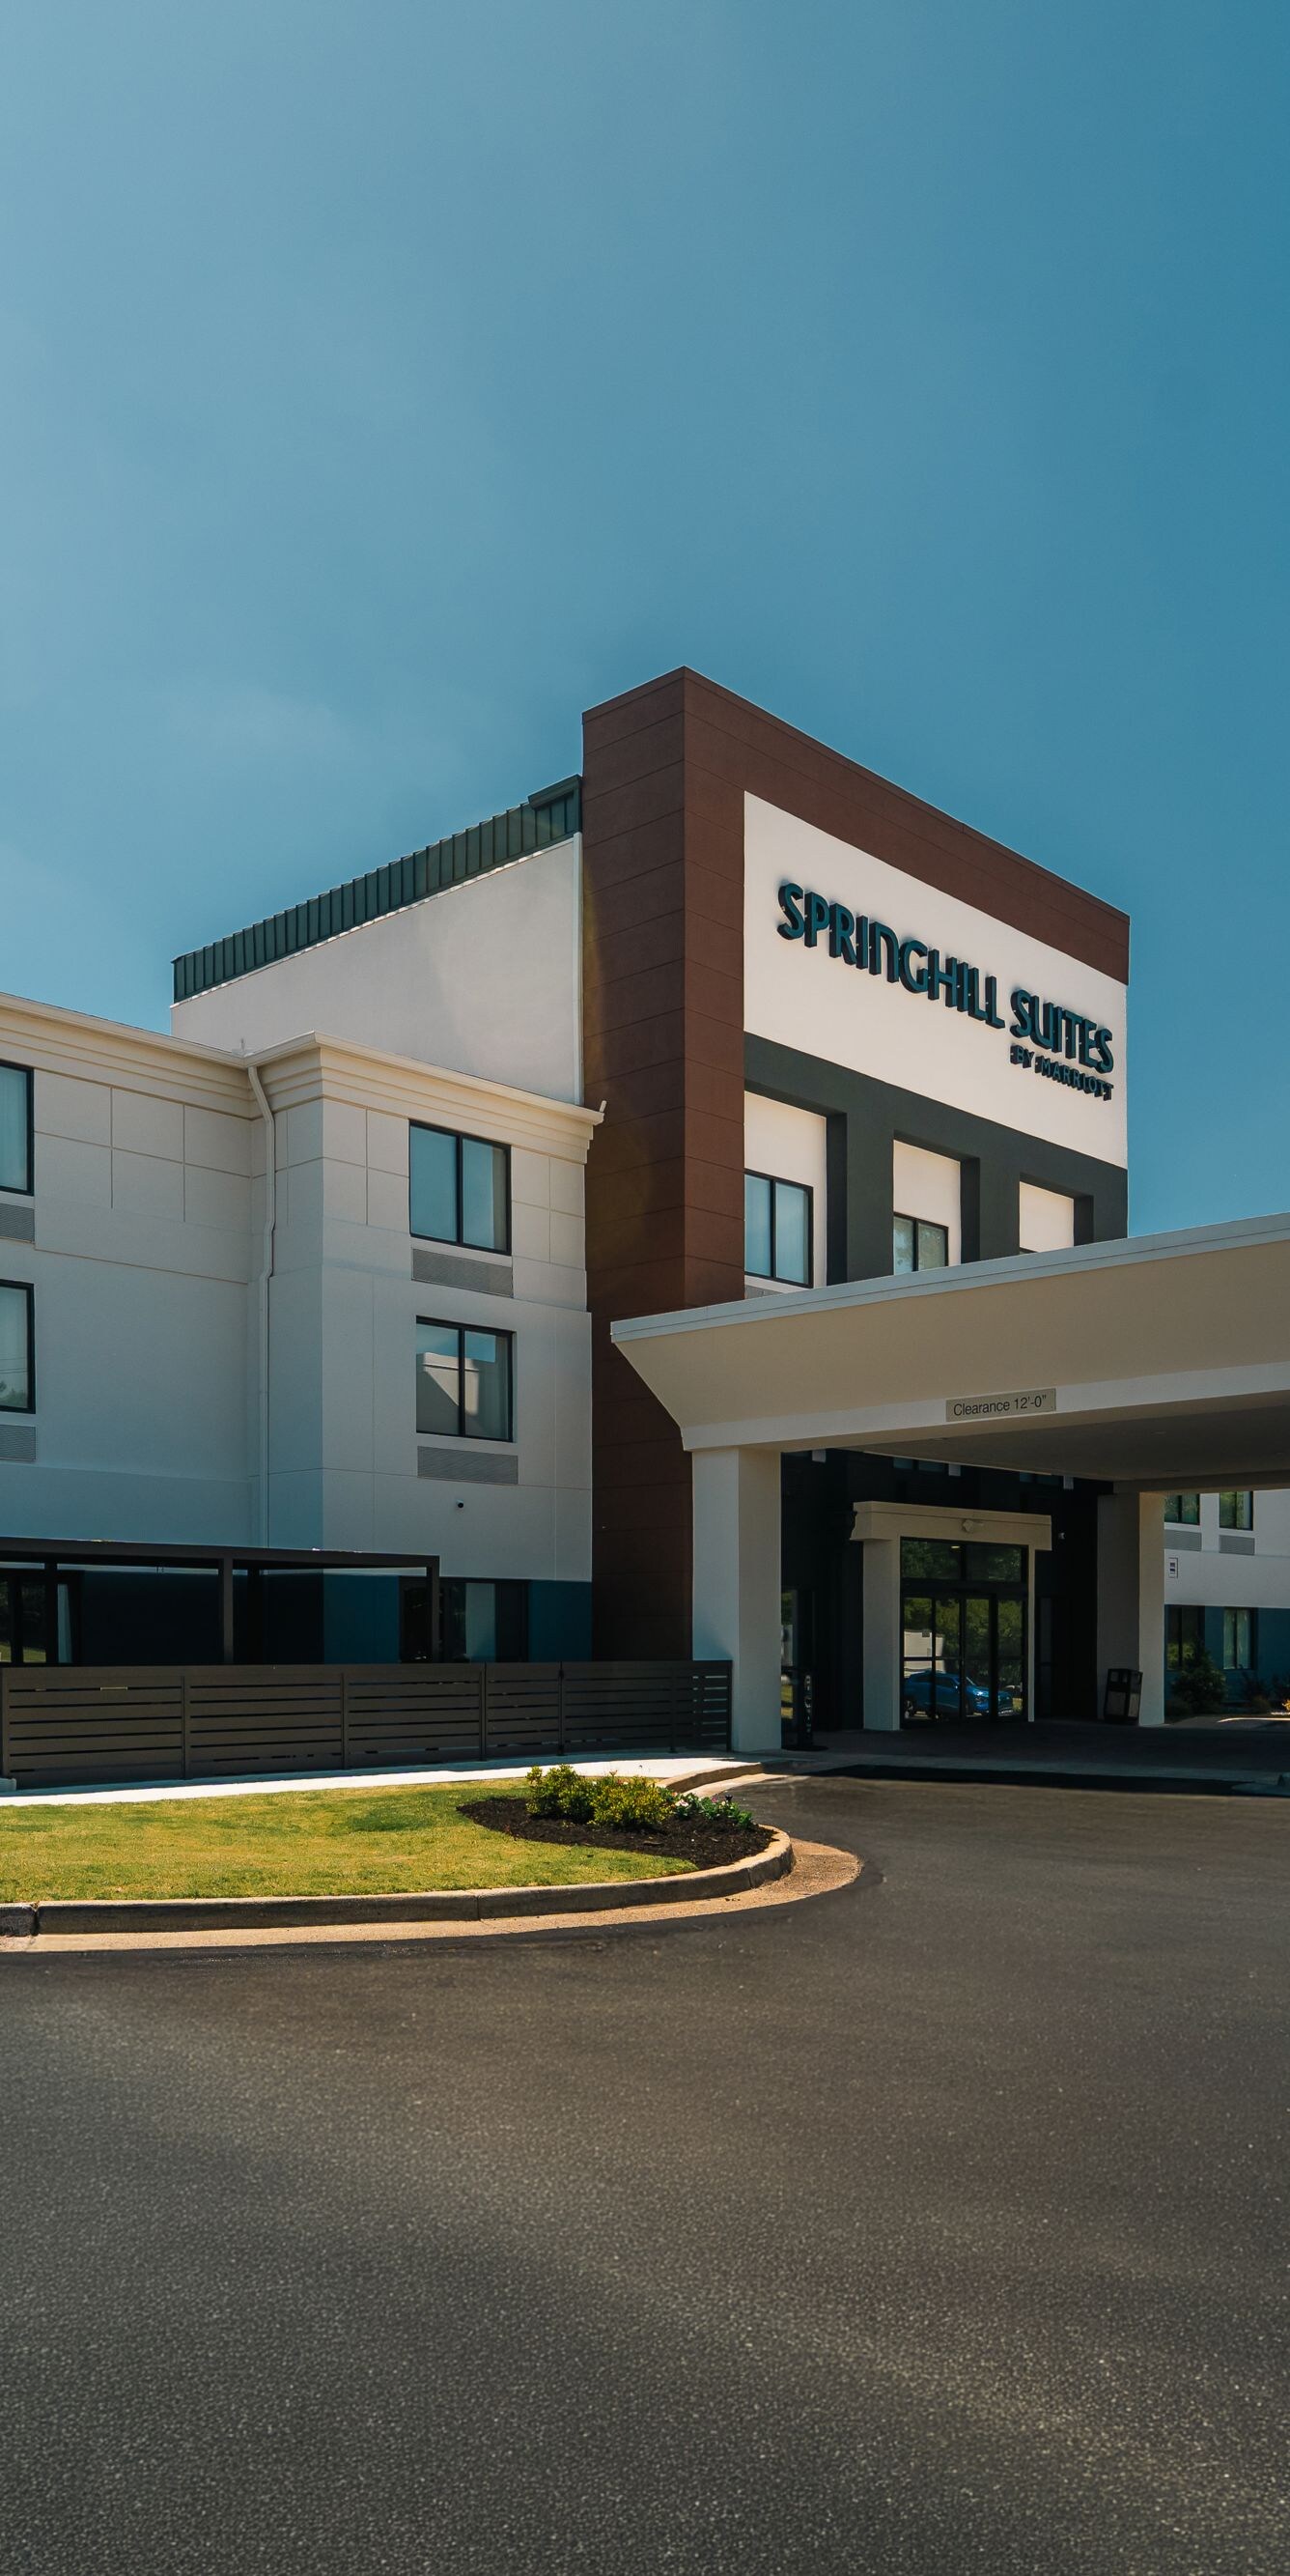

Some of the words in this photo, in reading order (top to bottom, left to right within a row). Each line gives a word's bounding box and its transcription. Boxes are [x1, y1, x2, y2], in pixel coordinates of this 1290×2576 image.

[777, 883, 1005, 1029] SPRINGHILL
[1010, 989, 1114, 1073] SUITES
[1010, 1045, 1035, 1068] BY
[1035, 1055, 1114, 1101] MARRIOTT
[953, 1401, 1010, 1416] Clearance
[1014, 1394, 1047, 1409] 12'-0"
